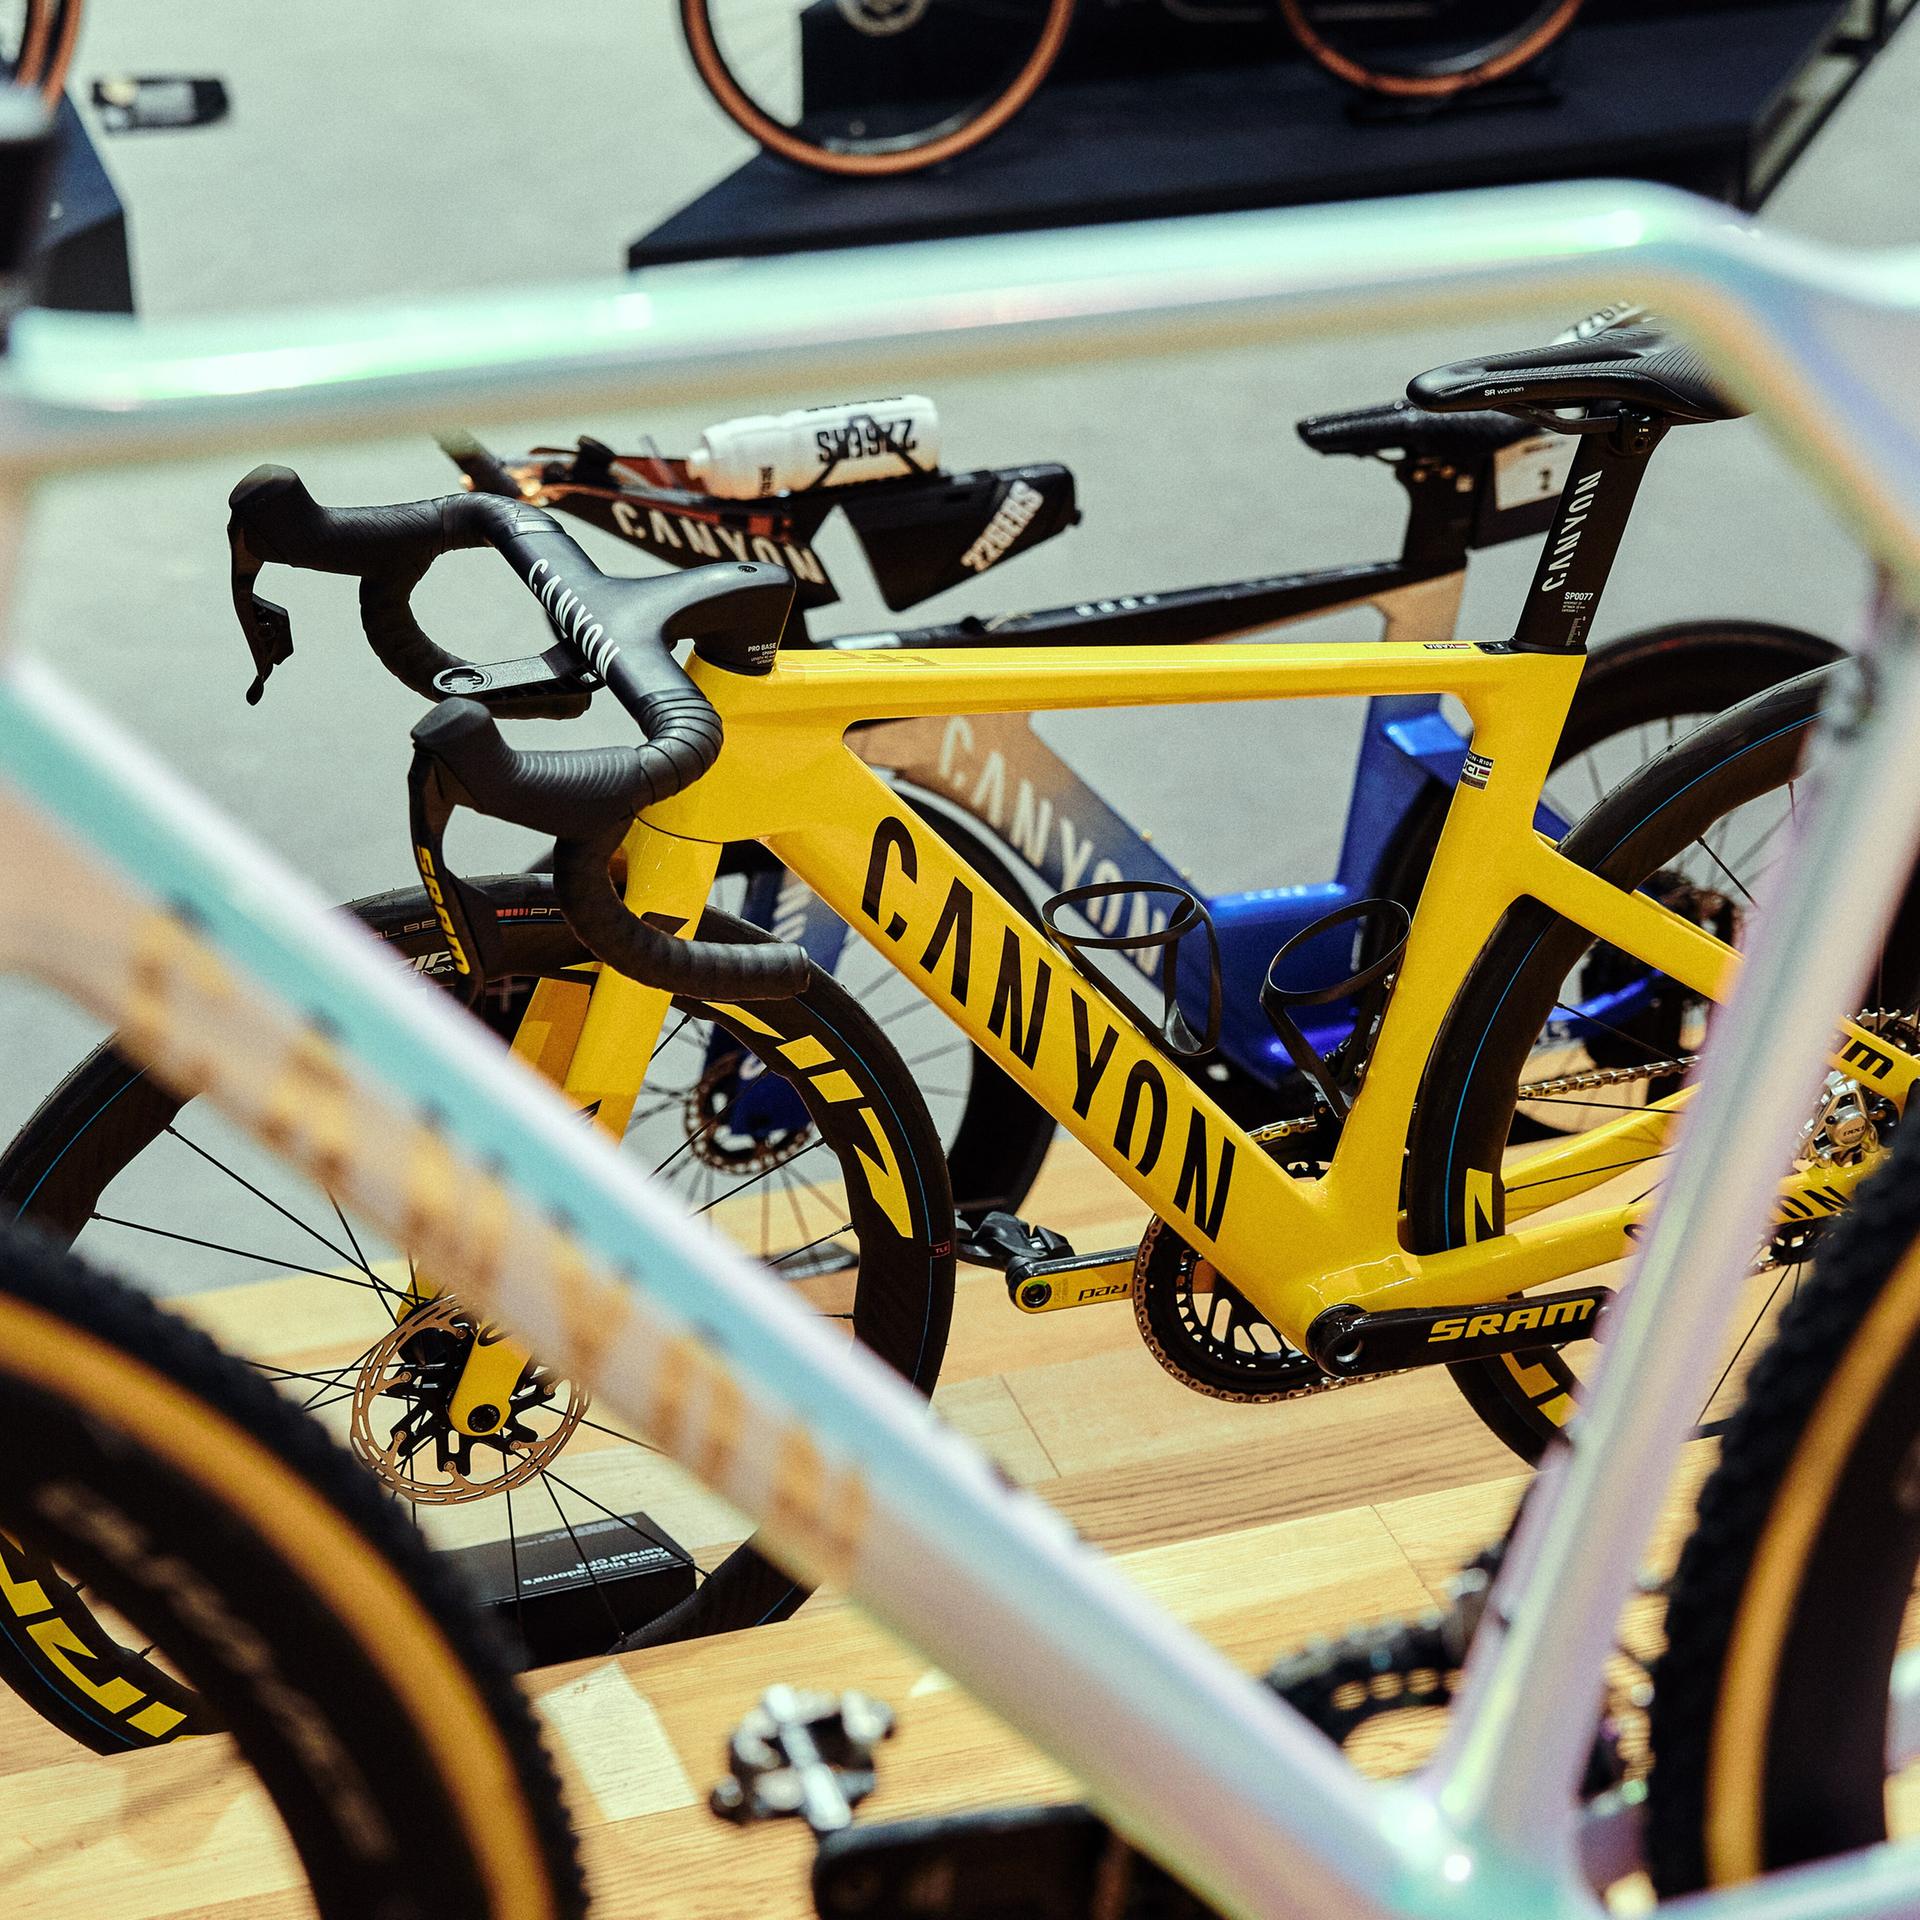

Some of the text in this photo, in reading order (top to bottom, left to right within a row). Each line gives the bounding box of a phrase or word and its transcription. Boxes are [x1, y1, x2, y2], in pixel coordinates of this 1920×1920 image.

[1497, 385, 1525, 395] women
[613, 501, 826, 585] CANYON
[1541, 469, 1604, 592] CANYON
[529, 557, 621, 683] CANYON
[937, 713, 1168, 978] CANYON
[416, 845, 471, 976] SRAM
[861, 816, 1236, 1243] CANYON
[1427, 1297, 1596, 1343] SRAM
